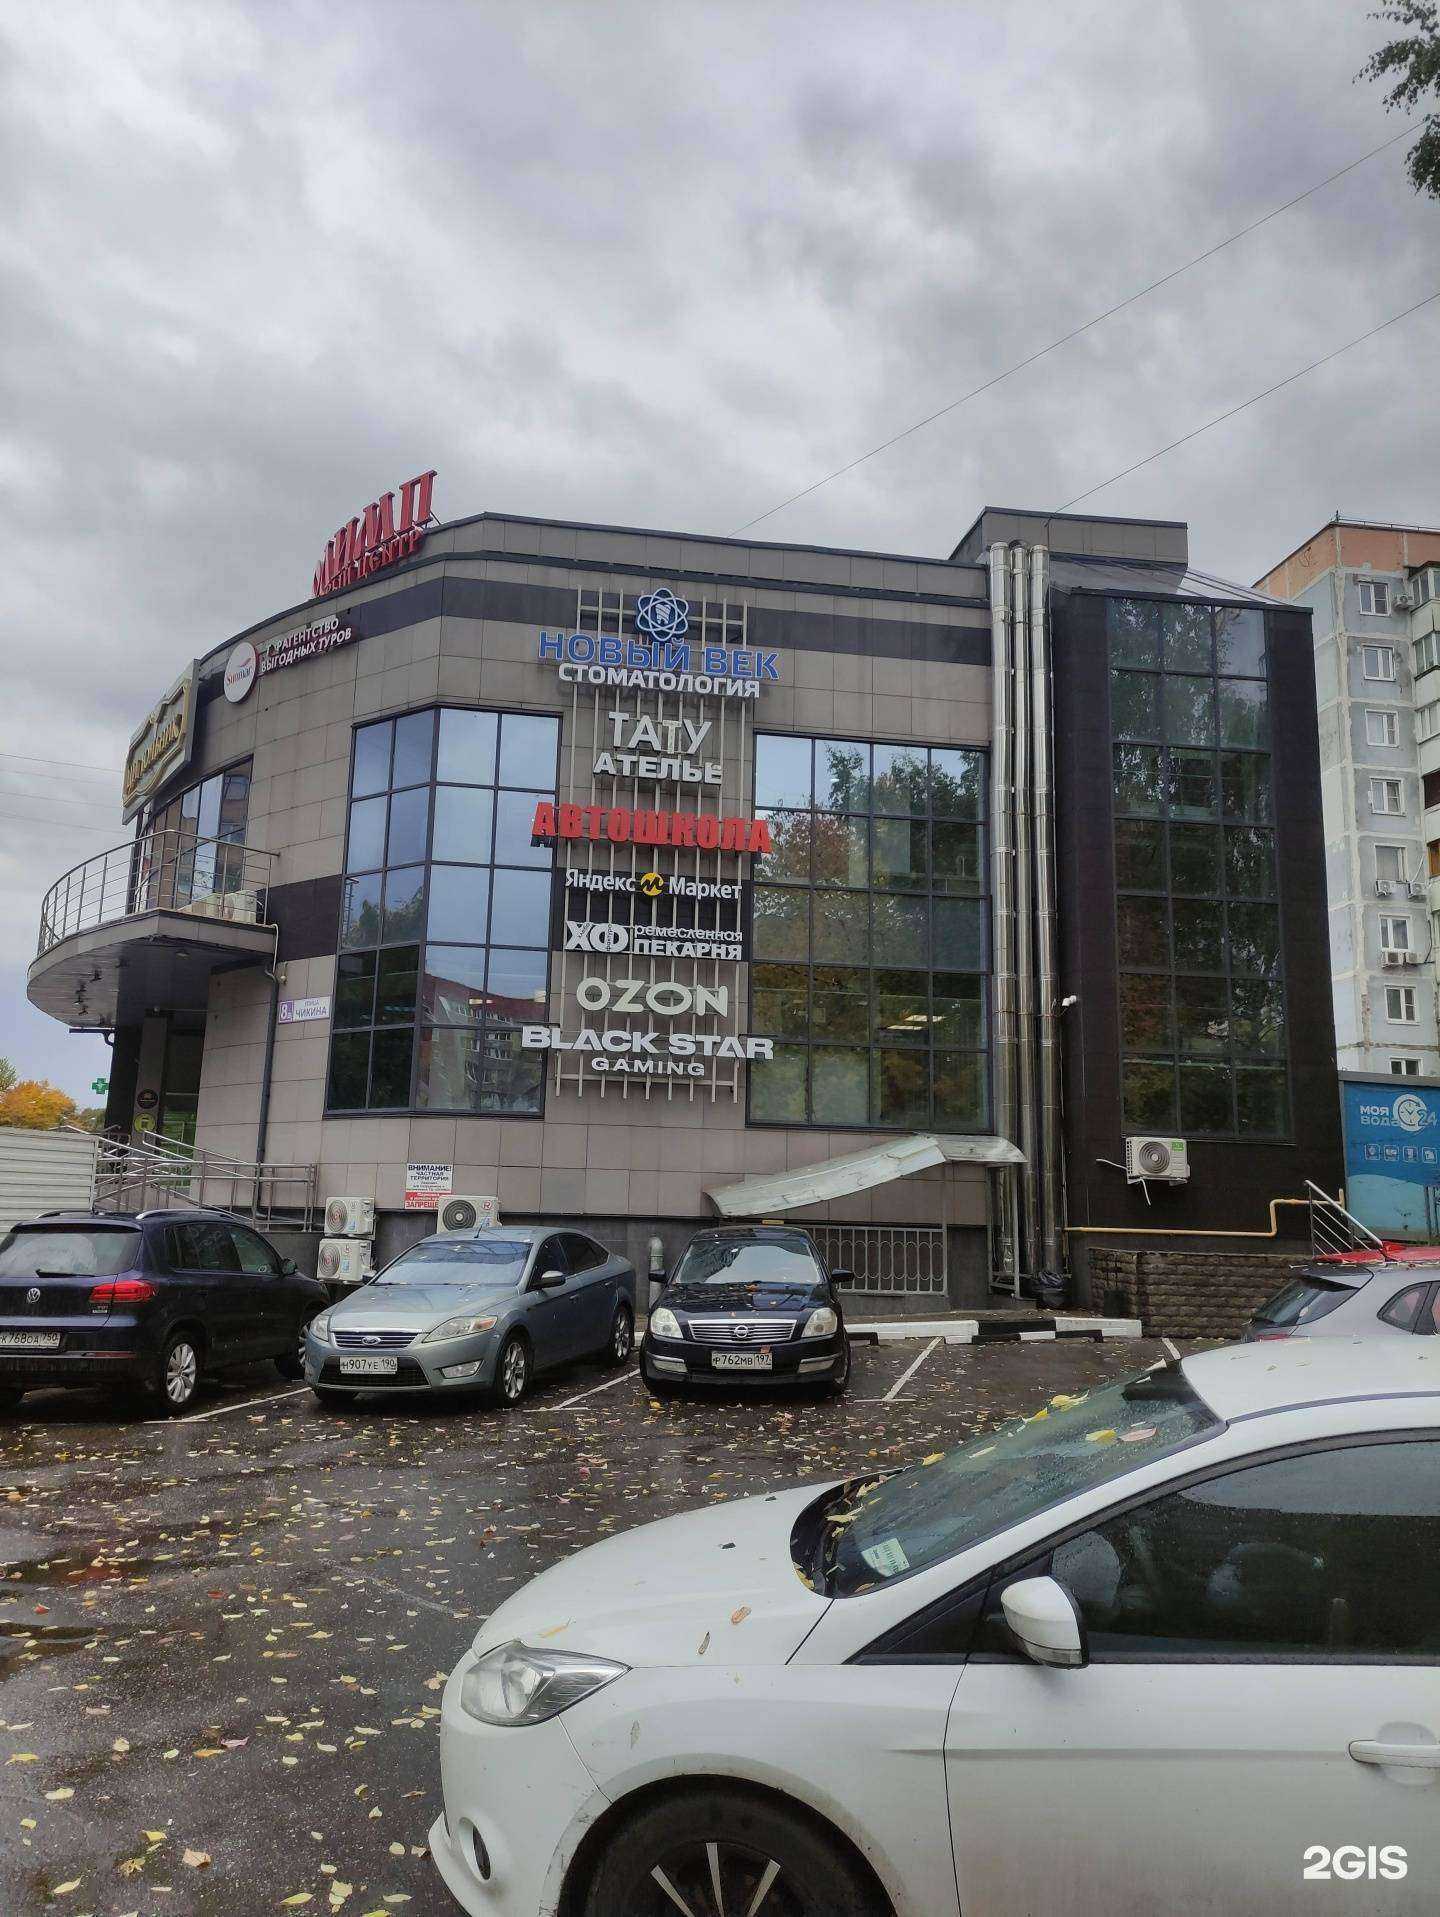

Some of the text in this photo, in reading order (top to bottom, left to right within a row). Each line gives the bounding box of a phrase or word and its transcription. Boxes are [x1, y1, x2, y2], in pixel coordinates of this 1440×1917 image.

[261, 628, 352, 673] ВЫГОДНЫХ ТУРОВ
[538, 631, 780, 680] НОВЫЙ ВЕК
[558, 663, 761, 698] СТОМАТОЛОГИЯ
[608, 711, 712, 755] ТАТУ
[593, 752, 723, 784] АТЕЛЬЕ
[532, 802, 773, 854] АВТОШКОЛА
[565, 869, 742, 900] Яндекс Маркет
[633, 924, 743, 942] ремесленная
[633, 938, 742, 960] ПЕКАРНЯ
[576, 976, 728, 1017] OZON
[522, 1025, 774, 1060] BLACK STAR
[591, 1057, 705, 1076] GAMING
[408, 1164, 452, 1172] ВНИМАНИЕ!
[405, 1201, 439, 1209] ЗАПРЕЩЕ
